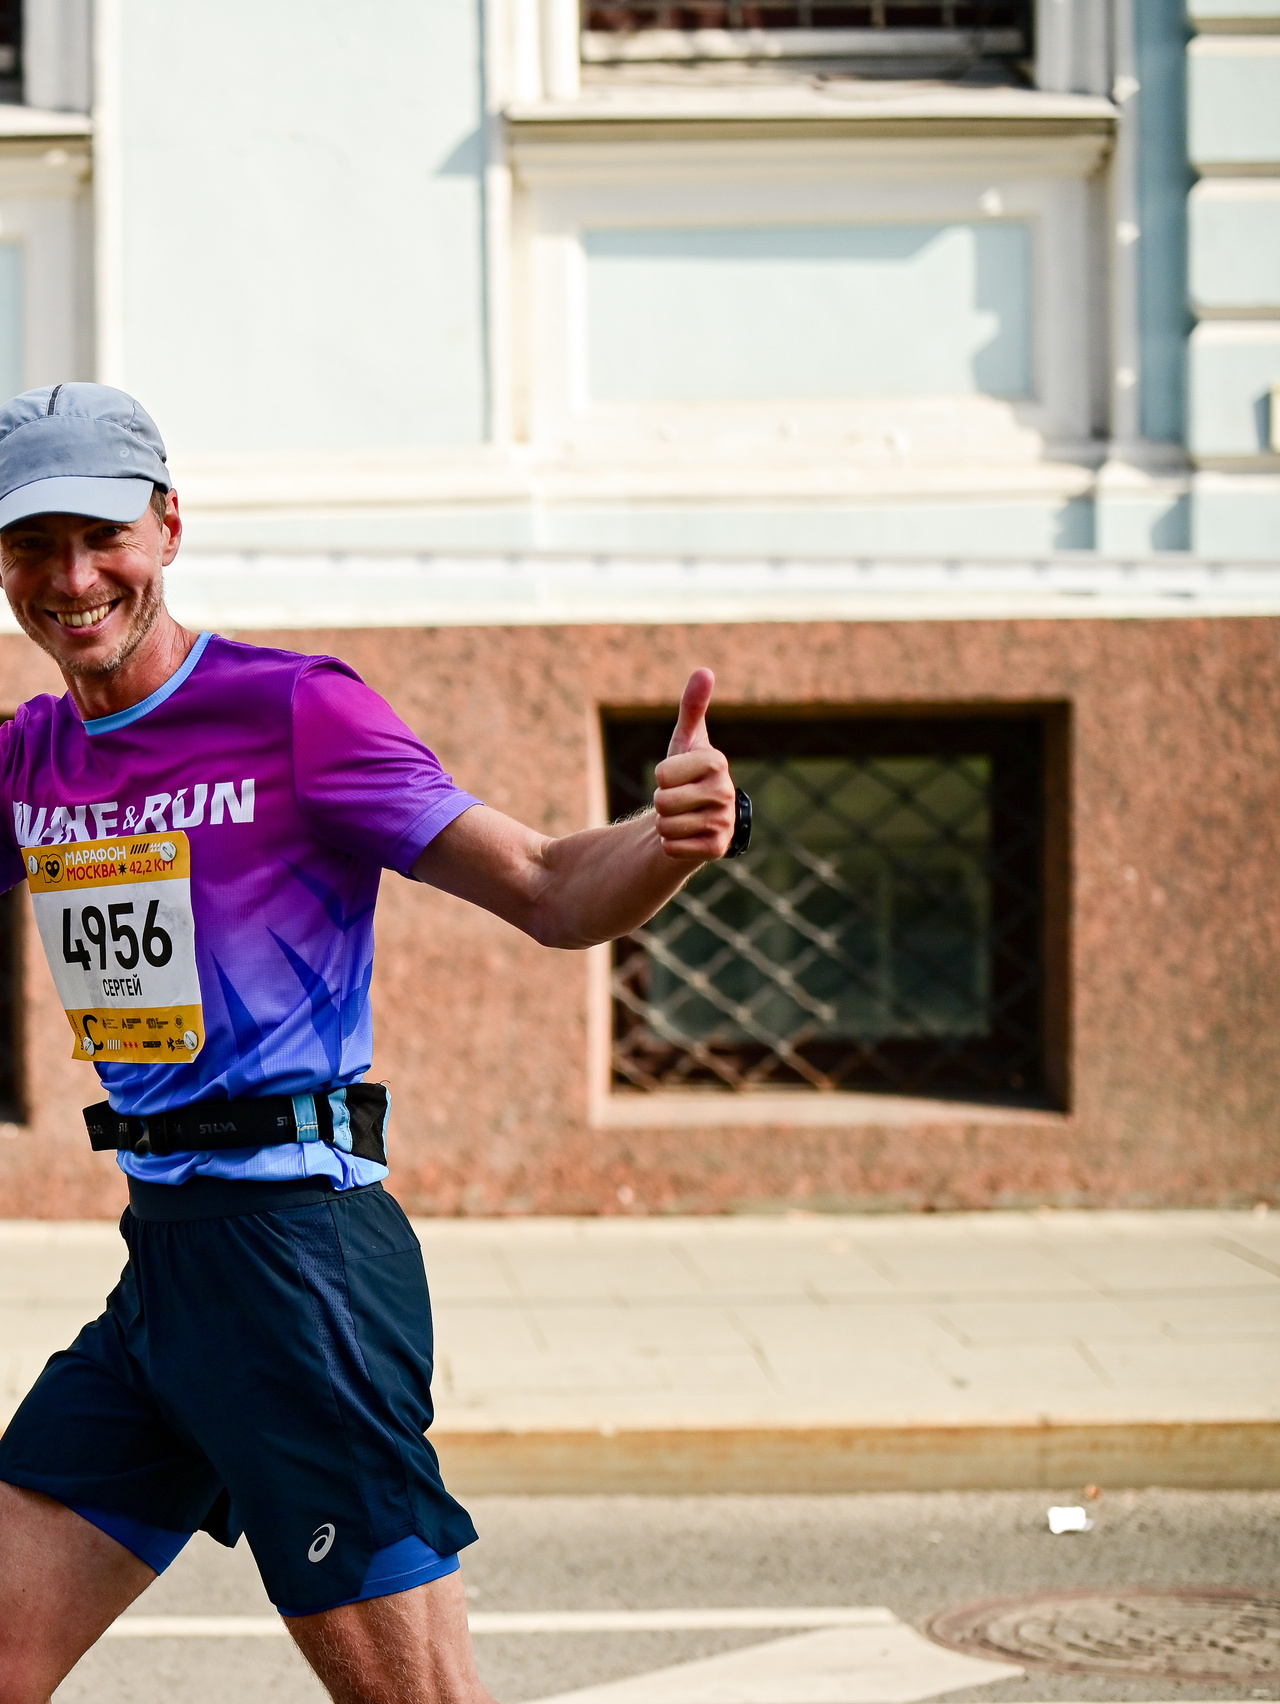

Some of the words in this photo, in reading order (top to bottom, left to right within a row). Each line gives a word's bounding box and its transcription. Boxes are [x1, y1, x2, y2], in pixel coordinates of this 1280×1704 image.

[65, 845, 127, 866] МАРАФОН
[66, 863, 118, 882] МОСКВА
[129, 860, 153, 876] 42,2
[154, 858, 174, 872] КМ
[62, 899, 173, 971] 4956
[102, 973, 143, 997] СЕРГЕЙ
[199, 1121, 238, 1134] SILVA
